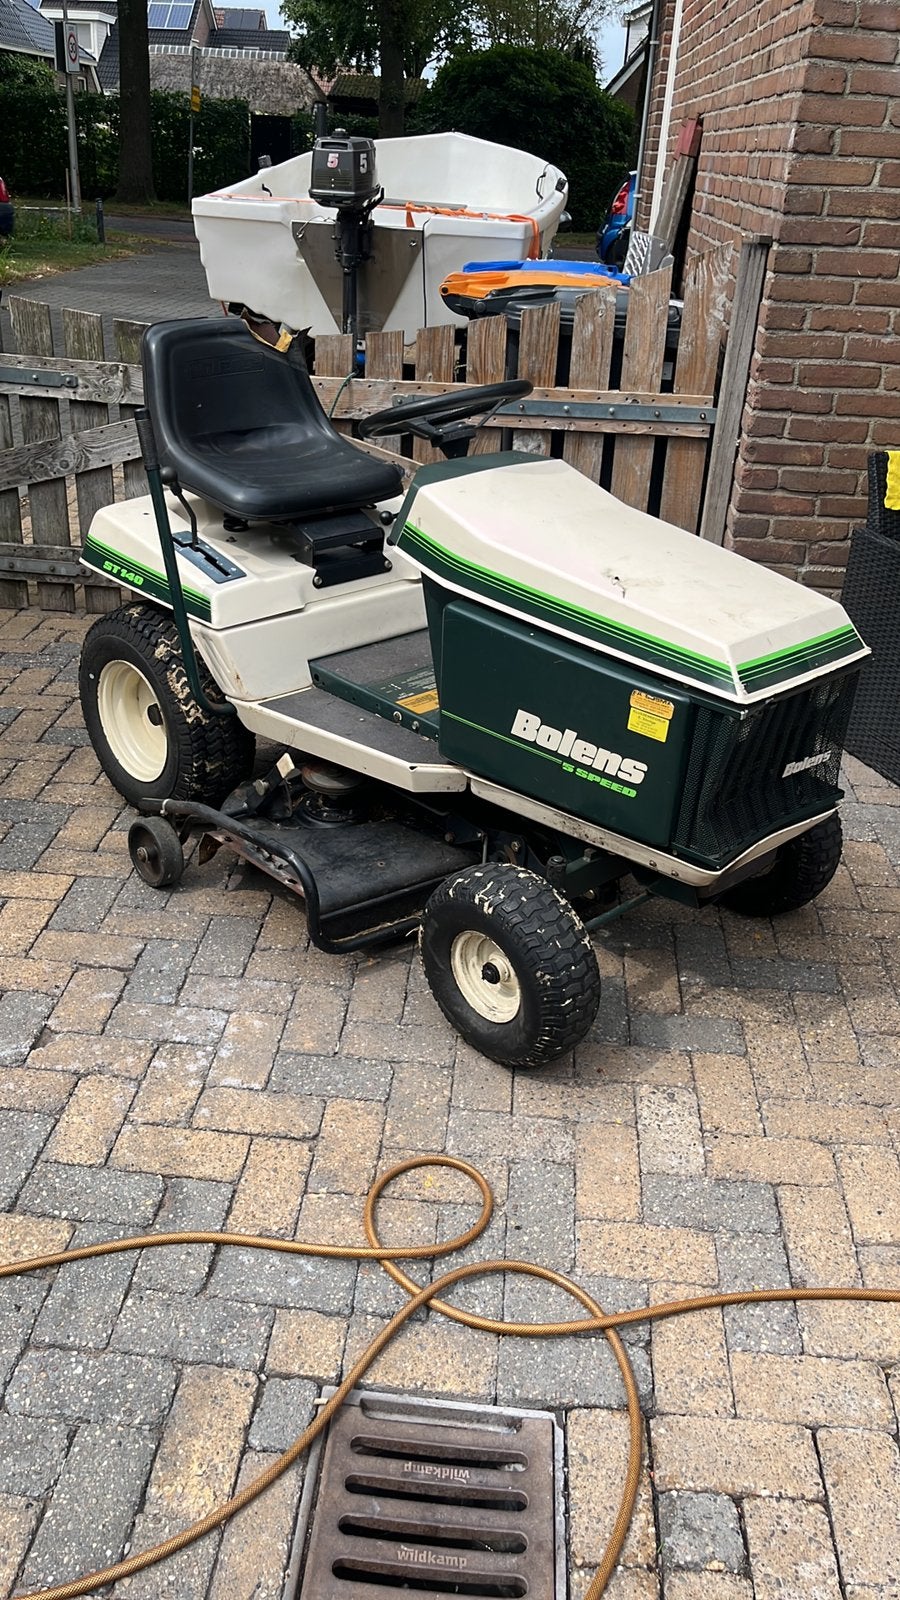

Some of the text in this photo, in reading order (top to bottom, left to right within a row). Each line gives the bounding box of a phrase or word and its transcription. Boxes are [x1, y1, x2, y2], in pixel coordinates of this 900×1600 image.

[327, 153, 339, 168] 5
[360, 153, 367, 174] 5
[511, 709, 648, 784] Bolens
[782, 750, 831, 778] Bolens
[562, 762, 637, 798] 5 SPEED
[403, 1461, 470, 1482] wildkamp
[397, 1545, 467, 1569] wildkamp
